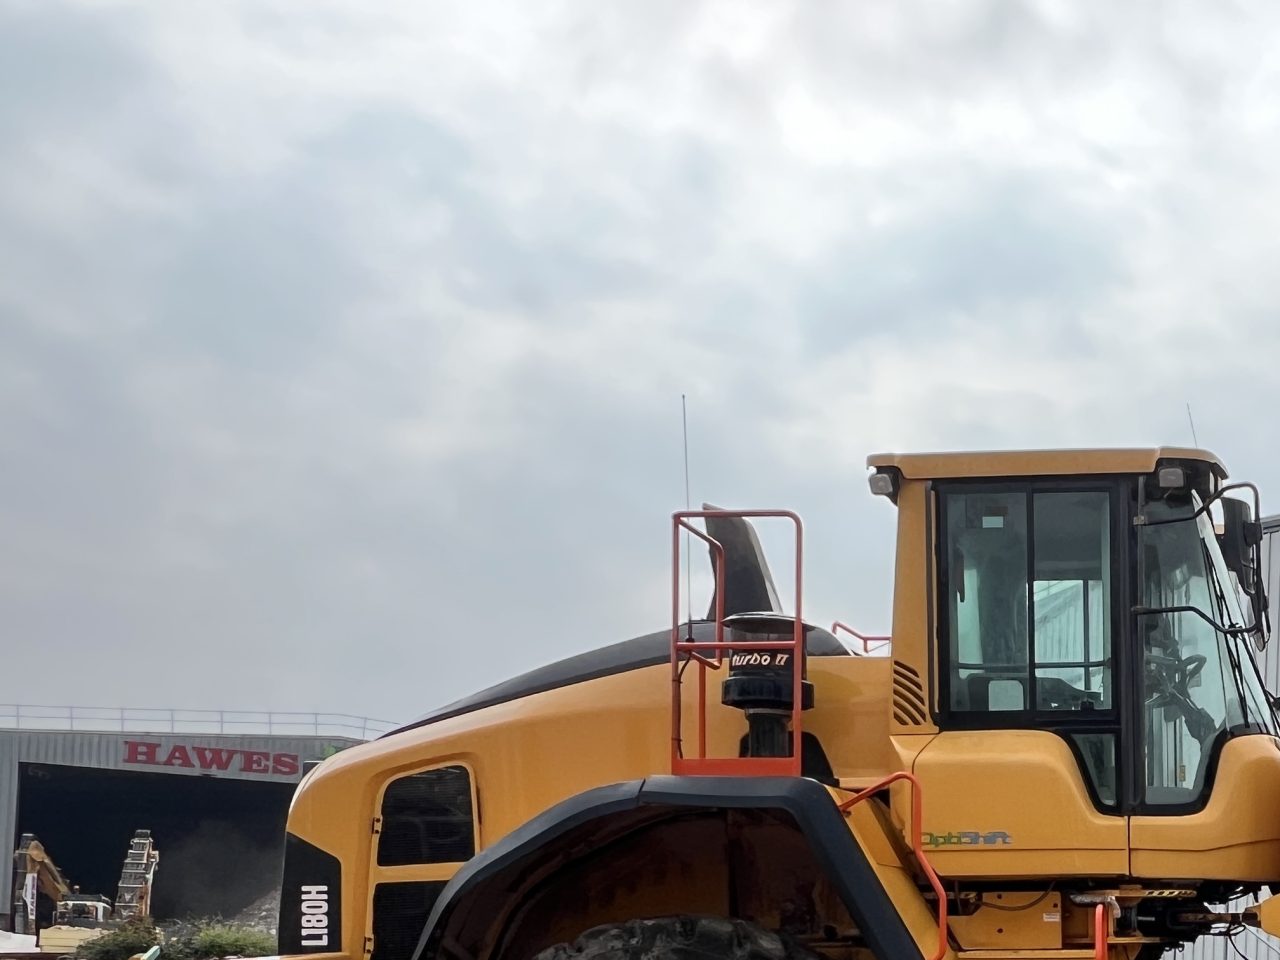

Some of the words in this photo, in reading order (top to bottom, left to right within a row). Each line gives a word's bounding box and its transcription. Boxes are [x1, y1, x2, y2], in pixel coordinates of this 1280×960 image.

[731, 652, 771, 667] turbo
[123, 740, 300, 775] HAWES
[301, 885, 328, 946] L180H
